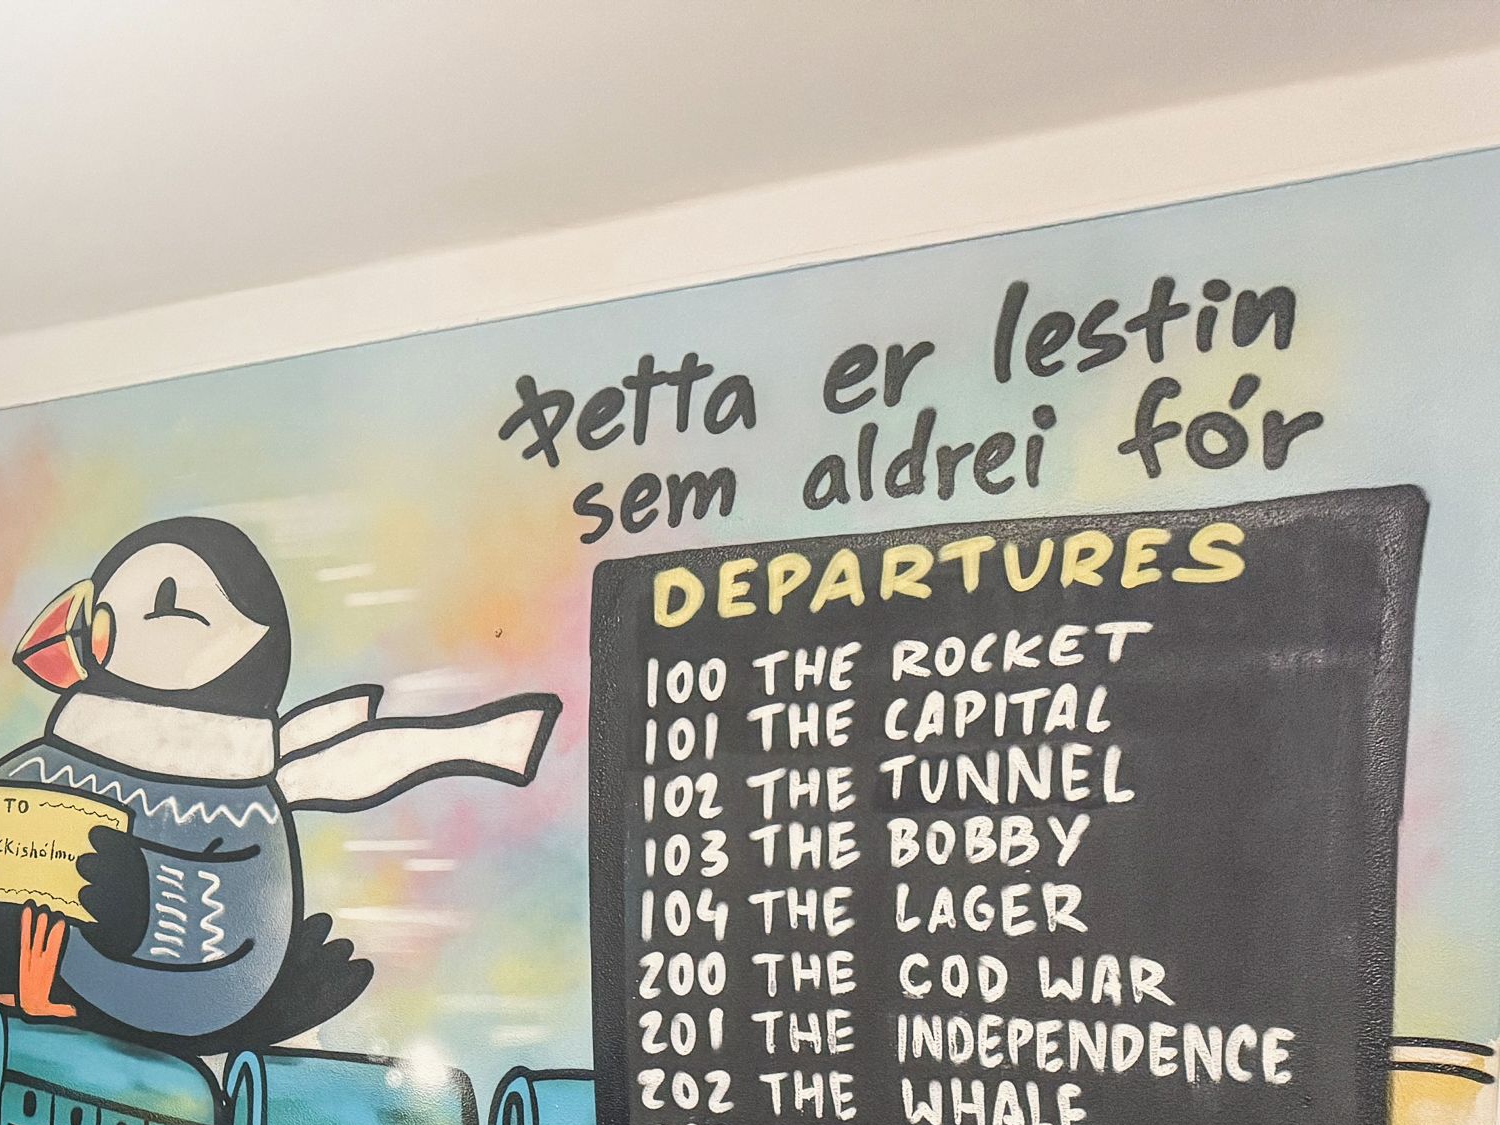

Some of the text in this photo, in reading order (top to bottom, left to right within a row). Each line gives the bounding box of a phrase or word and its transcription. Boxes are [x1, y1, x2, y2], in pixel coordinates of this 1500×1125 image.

[823, 340, 936, 415] er
[993, 276, 1297, 384] lestin
[572, 373, 1324, 545] sem aldrei fór
[653, 521, 1246, 628] DEPARTURES
[647, 621, 1154, 708] 100 THE ROCKET
[645, 682, 1111, 765] 101 THE CAPITAL
[3, 797, 30, 814] TO
[643, 742, 1136, 822] 102 THE TUNNEL
[645, 813, 1091, 878] 103 THE BOBBY
[641, 881, 1089, 942] 104 THE LAGER
[638, 950, 1176, 1007] 200 THE COD WAR
[638, 1007, 1297, 1085] 201 THE INDEPENDENCE
[637, 1068, 735, 1114] 202
[758, 1070, 857, 1121] THE
